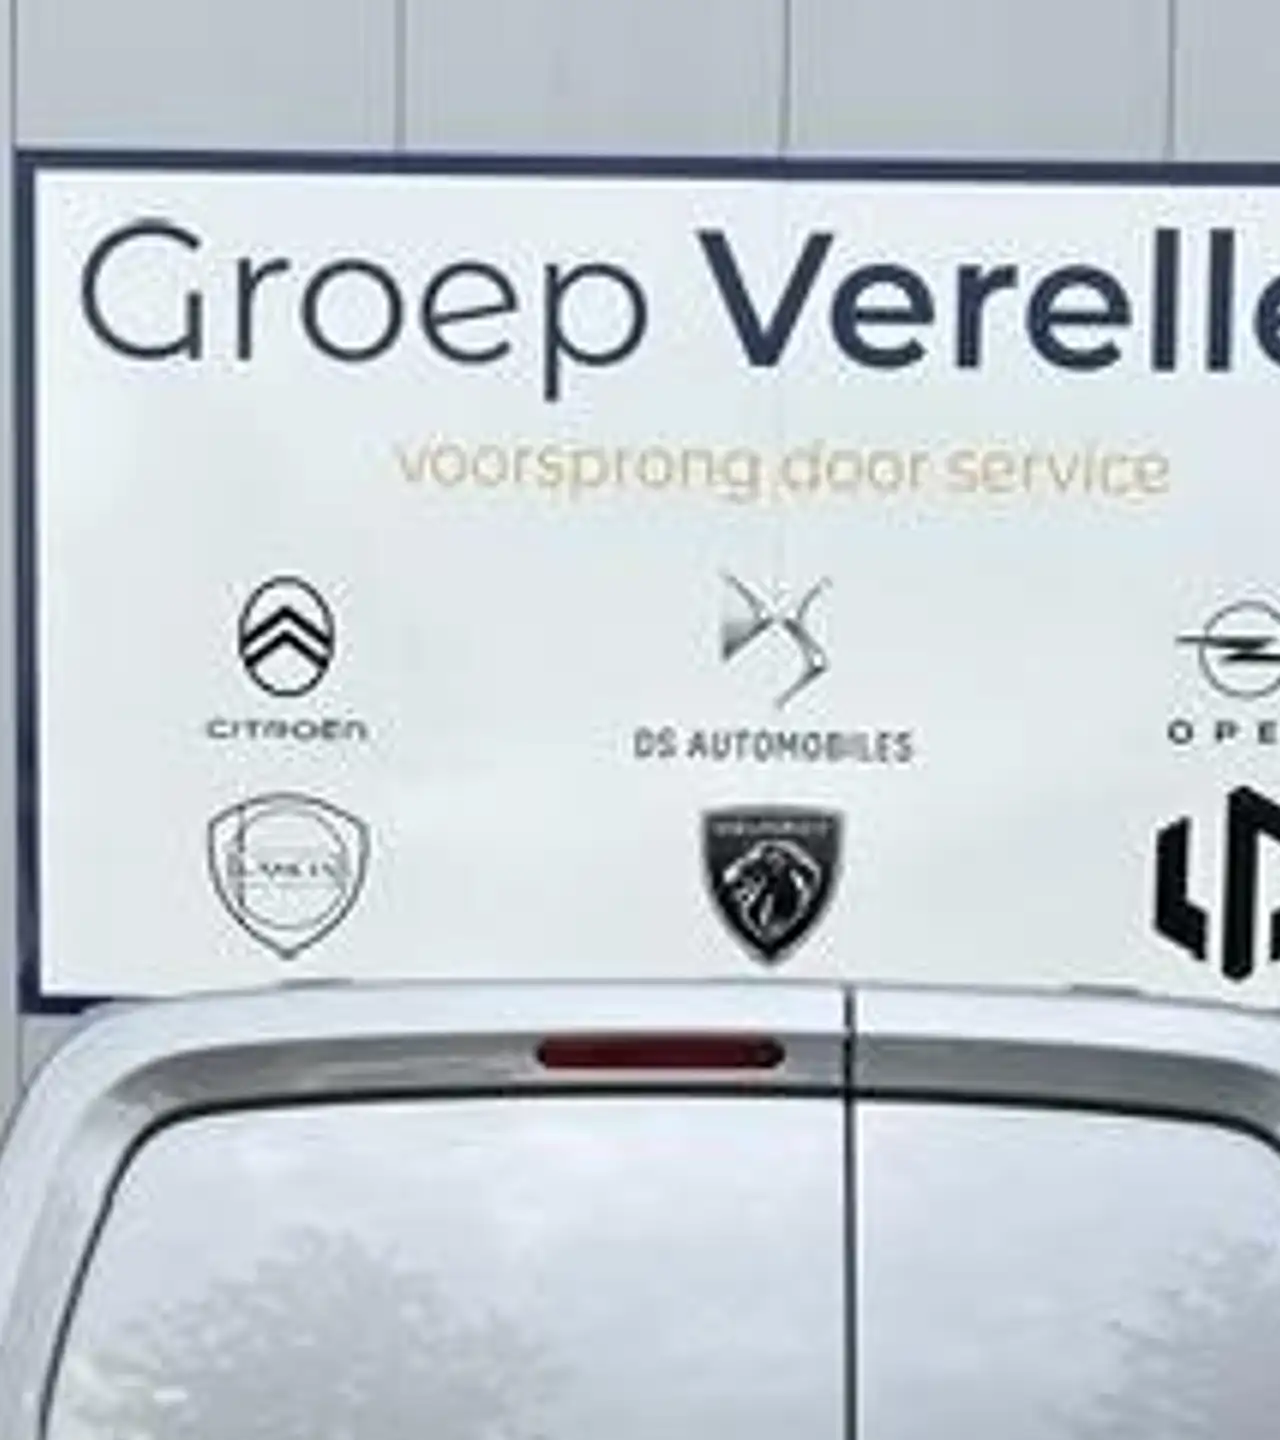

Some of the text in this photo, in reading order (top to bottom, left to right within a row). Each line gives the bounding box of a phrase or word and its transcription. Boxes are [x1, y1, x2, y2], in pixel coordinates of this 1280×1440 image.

[81, 217, 648, 403] Groep
[397, 437, 1172, 506] voorsprong door service
[632, 726, 679, 760] DS
